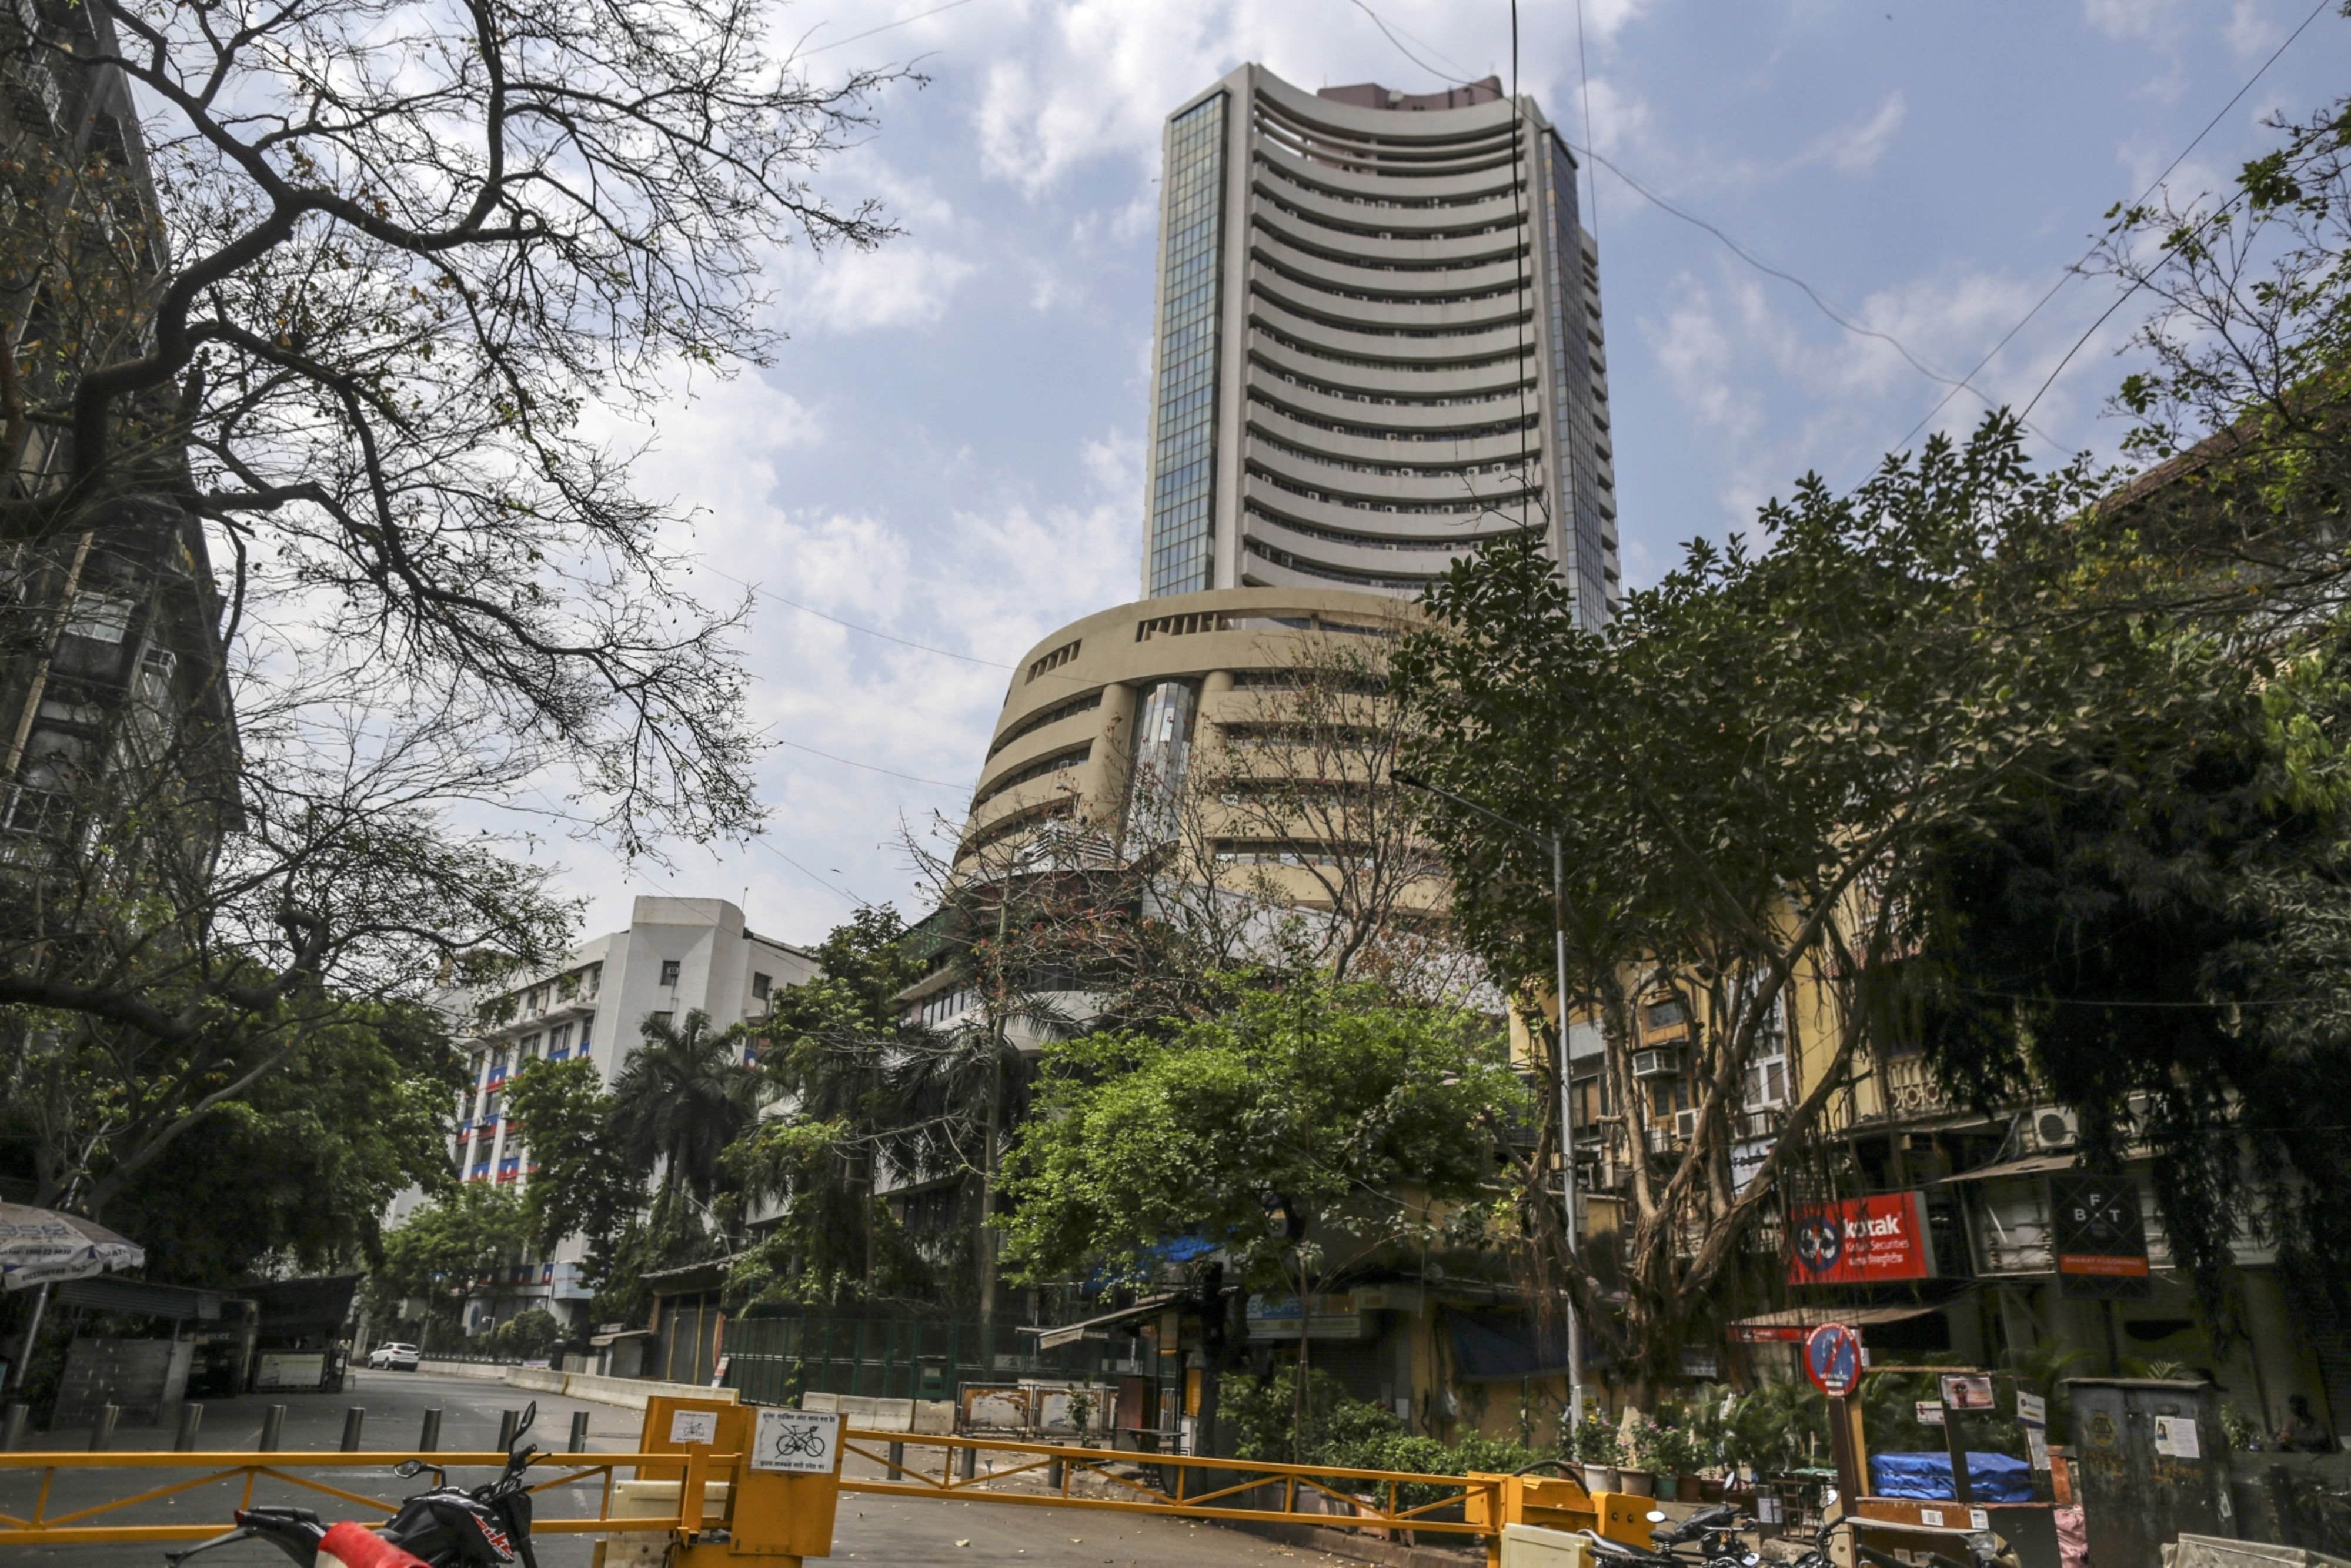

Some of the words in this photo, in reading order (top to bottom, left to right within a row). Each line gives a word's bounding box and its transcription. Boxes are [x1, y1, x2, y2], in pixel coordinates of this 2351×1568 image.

[2089, 1193, 2101, 1206] F
[2073, 1208, 2086, 1221] B
[2108, 1209, 2120, 1222] T
[1843, 1213, 1901, 1239] kotak
[1870, 1238, 1909, 1251] Securities
